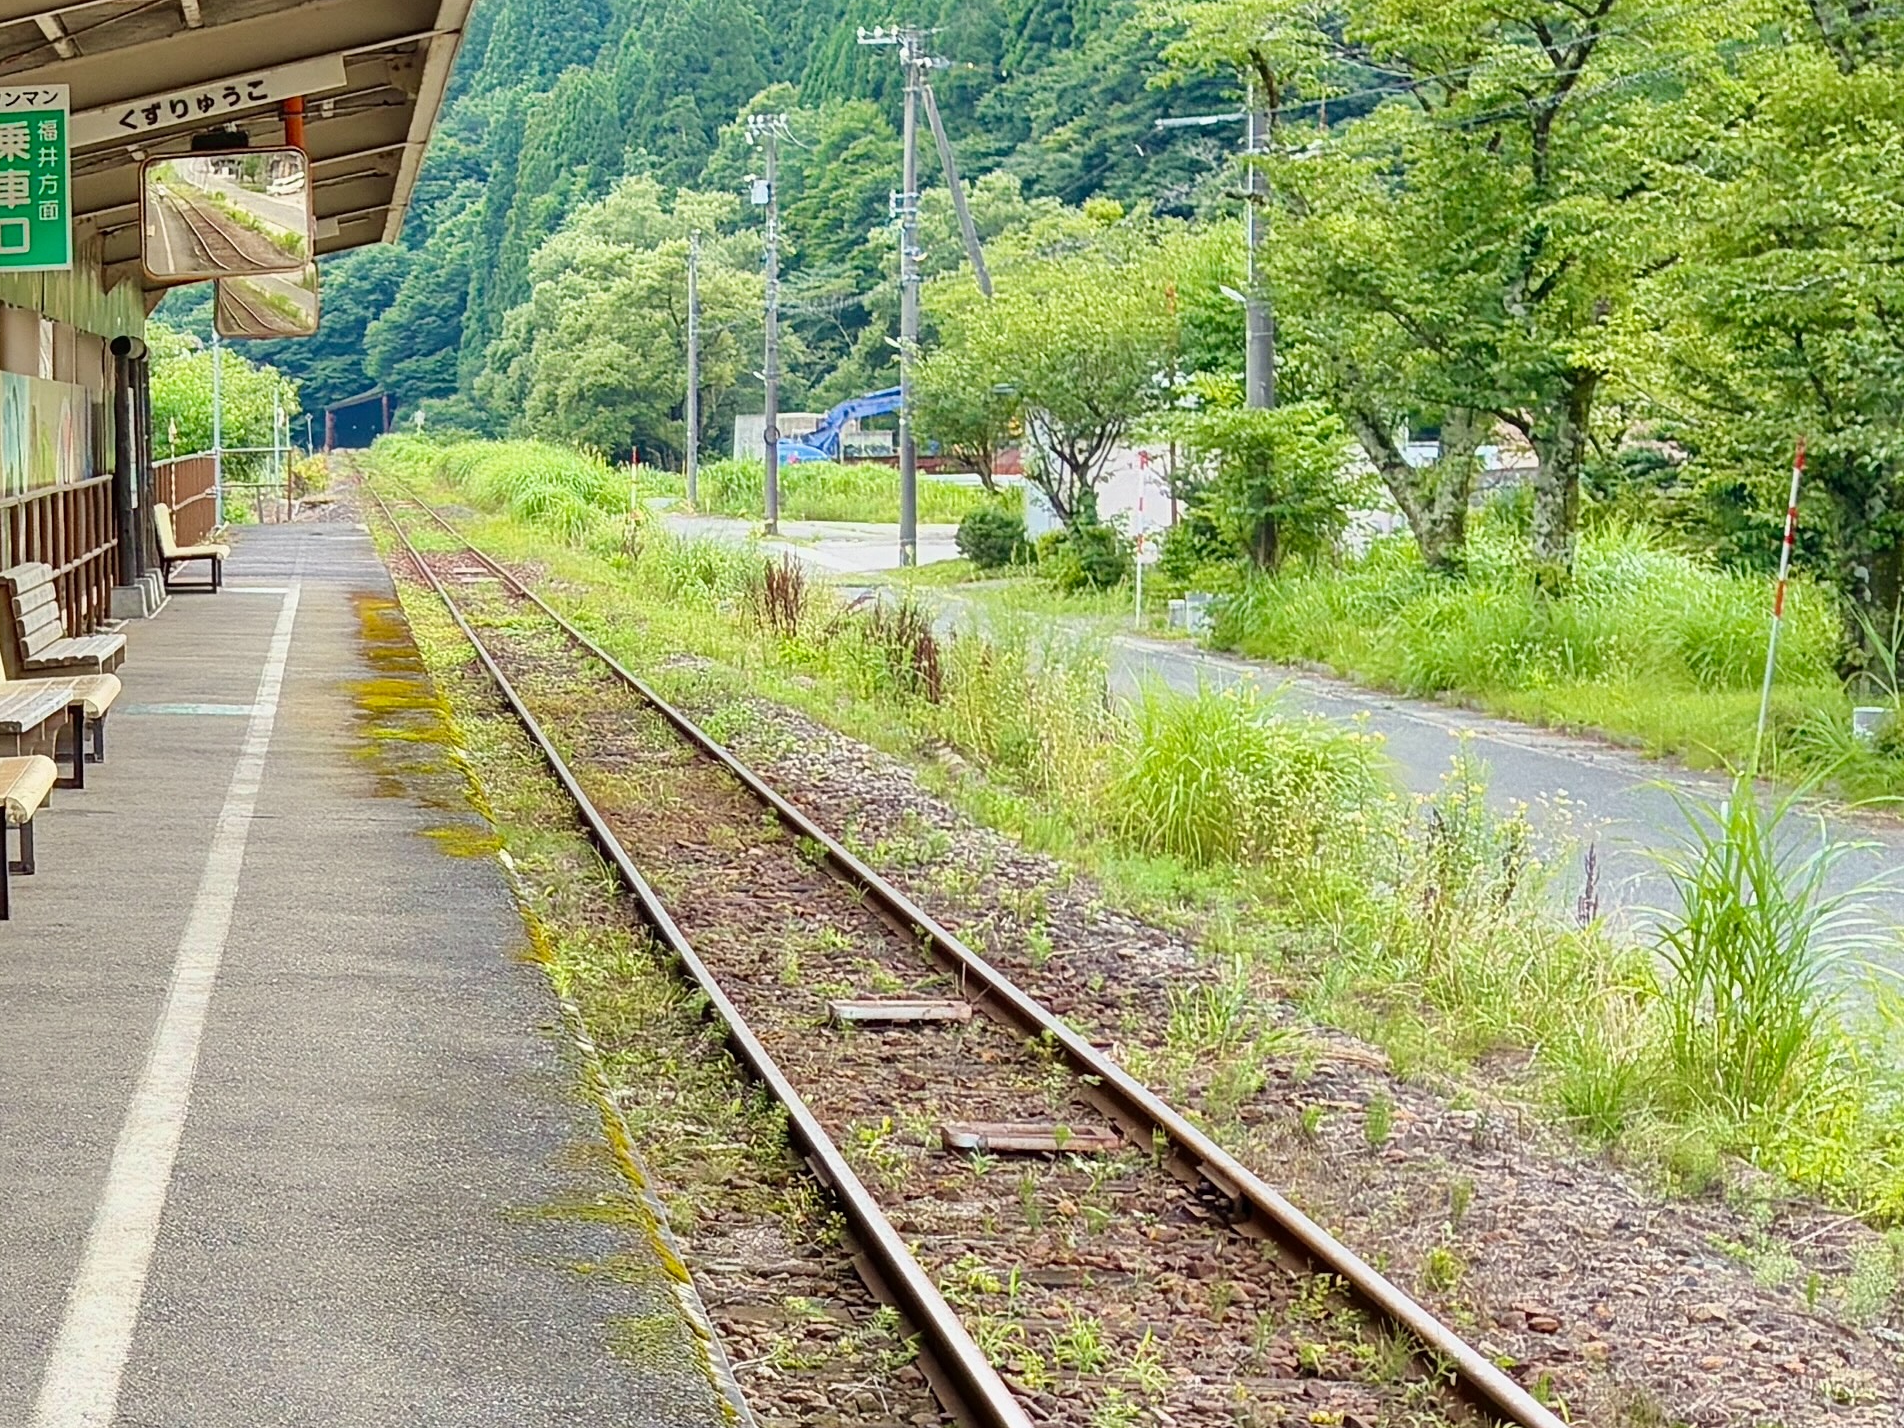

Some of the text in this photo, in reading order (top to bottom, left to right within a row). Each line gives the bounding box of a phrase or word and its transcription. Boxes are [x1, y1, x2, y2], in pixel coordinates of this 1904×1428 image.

[119, 80, 268, 130] くずりゅうこ
[37, 119, 60, 221] 福井方面
